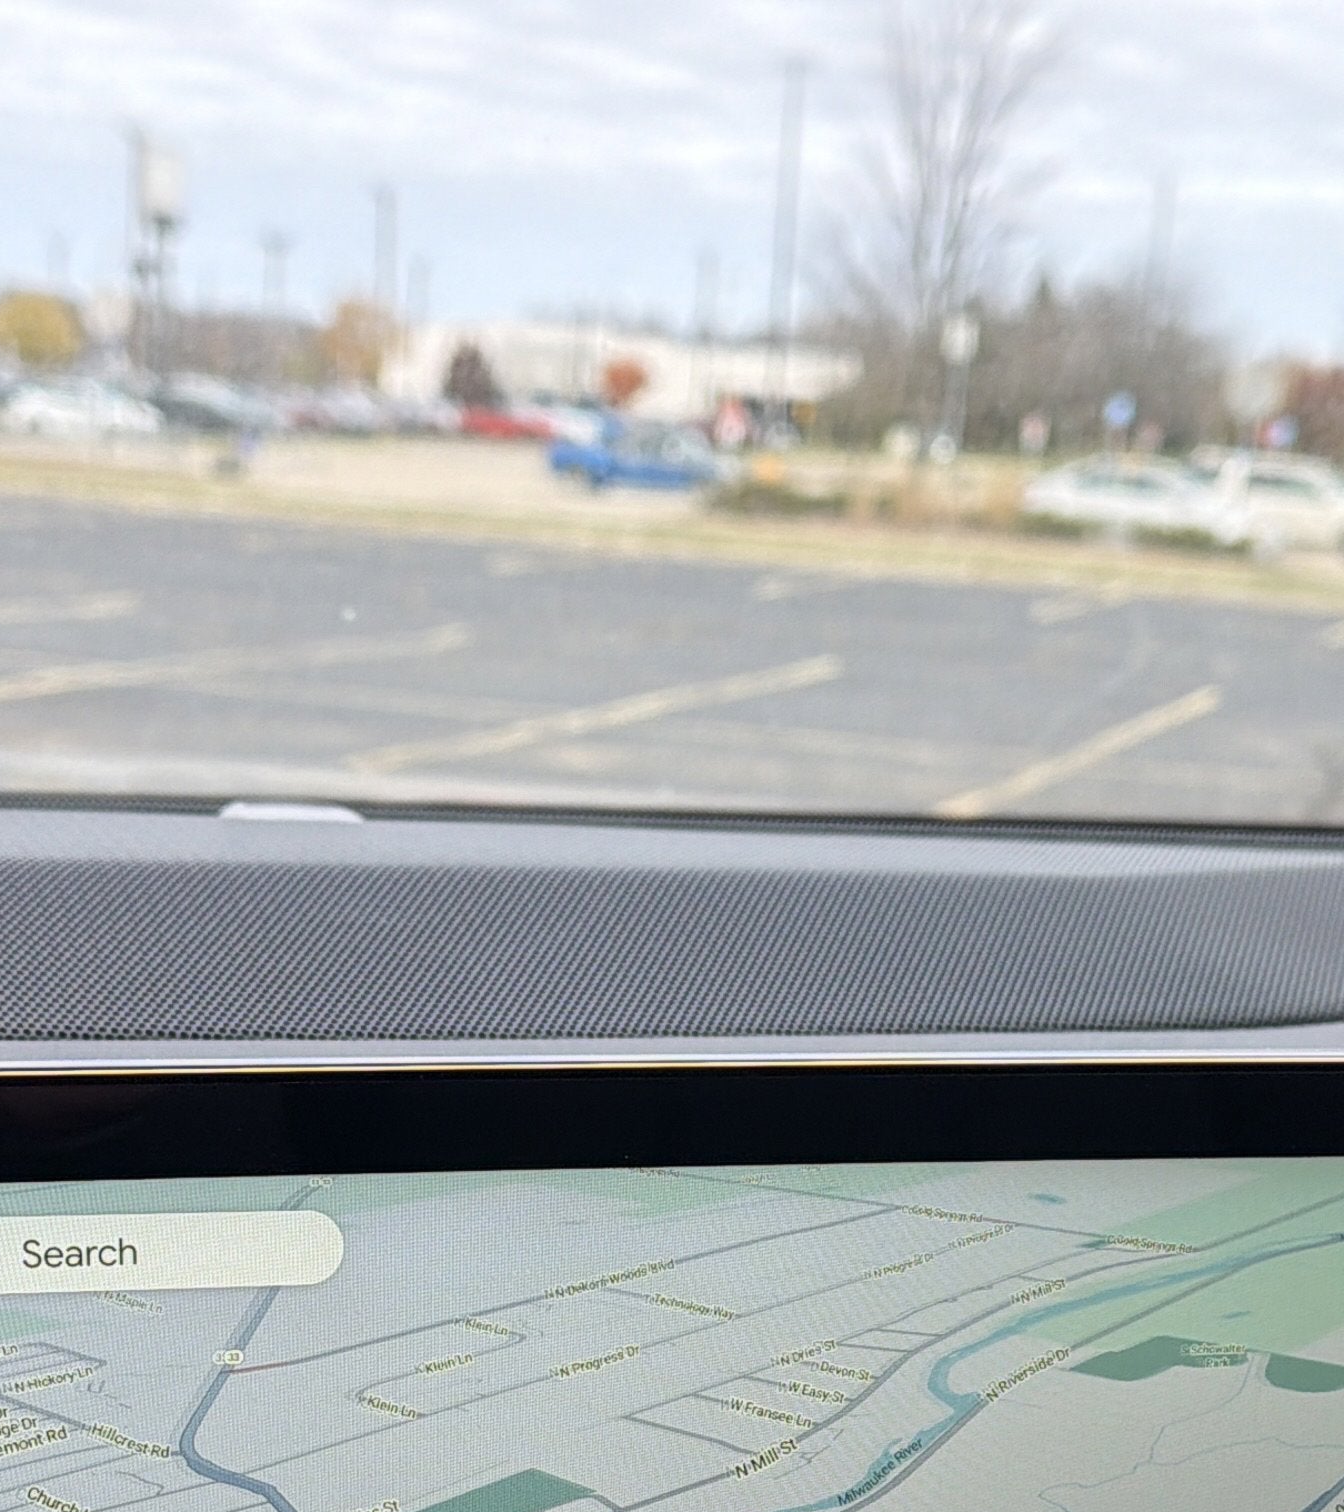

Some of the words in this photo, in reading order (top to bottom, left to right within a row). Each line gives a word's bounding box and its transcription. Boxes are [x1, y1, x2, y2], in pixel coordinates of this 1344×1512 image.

[23, 1238, 137, 1268] Search
[714, 1306, 734, 1321] Way
[494, 1323, 508, 1335] Ln
[572, 1351, 625, 1374] Progress
[627, 1345, 639, 1357] Dr
[792, 1345, 823, 1363] Dries
[27, 1372, 75, 1390] Hickory
[77, 1366, 93, 1378] Ln
[820, 1362, 854, 1379] Devon
[856, 1370, 870, 1382] St
[998, 1358, 1054, 1392] Riverside
[1056, 1348, 1071, 1361] Dr
[802, 1384, 828, 1403] Easy
[830, 1391, 844, 1404] St
[21, 1417, 38, 1430] Dr
[400, 1406, 416, 1420] Ln
[745, 1401, 794, 1424] Fransee
[796, 1414, 812, 1428] Ln
[47, 1428, 68, 1443] Rd
[93, 1424, 148, 1455] Hillcrest
[150, 1443, 171, 1459] Rd
[734, 1462, 748, 1480] N
[750, 1449, 778, 1473] Mill
[780, 1438, 798, 1456] St
[837, 1460, 894, 1506] Milwaukee
[894, 1438, 924, 1465] River
